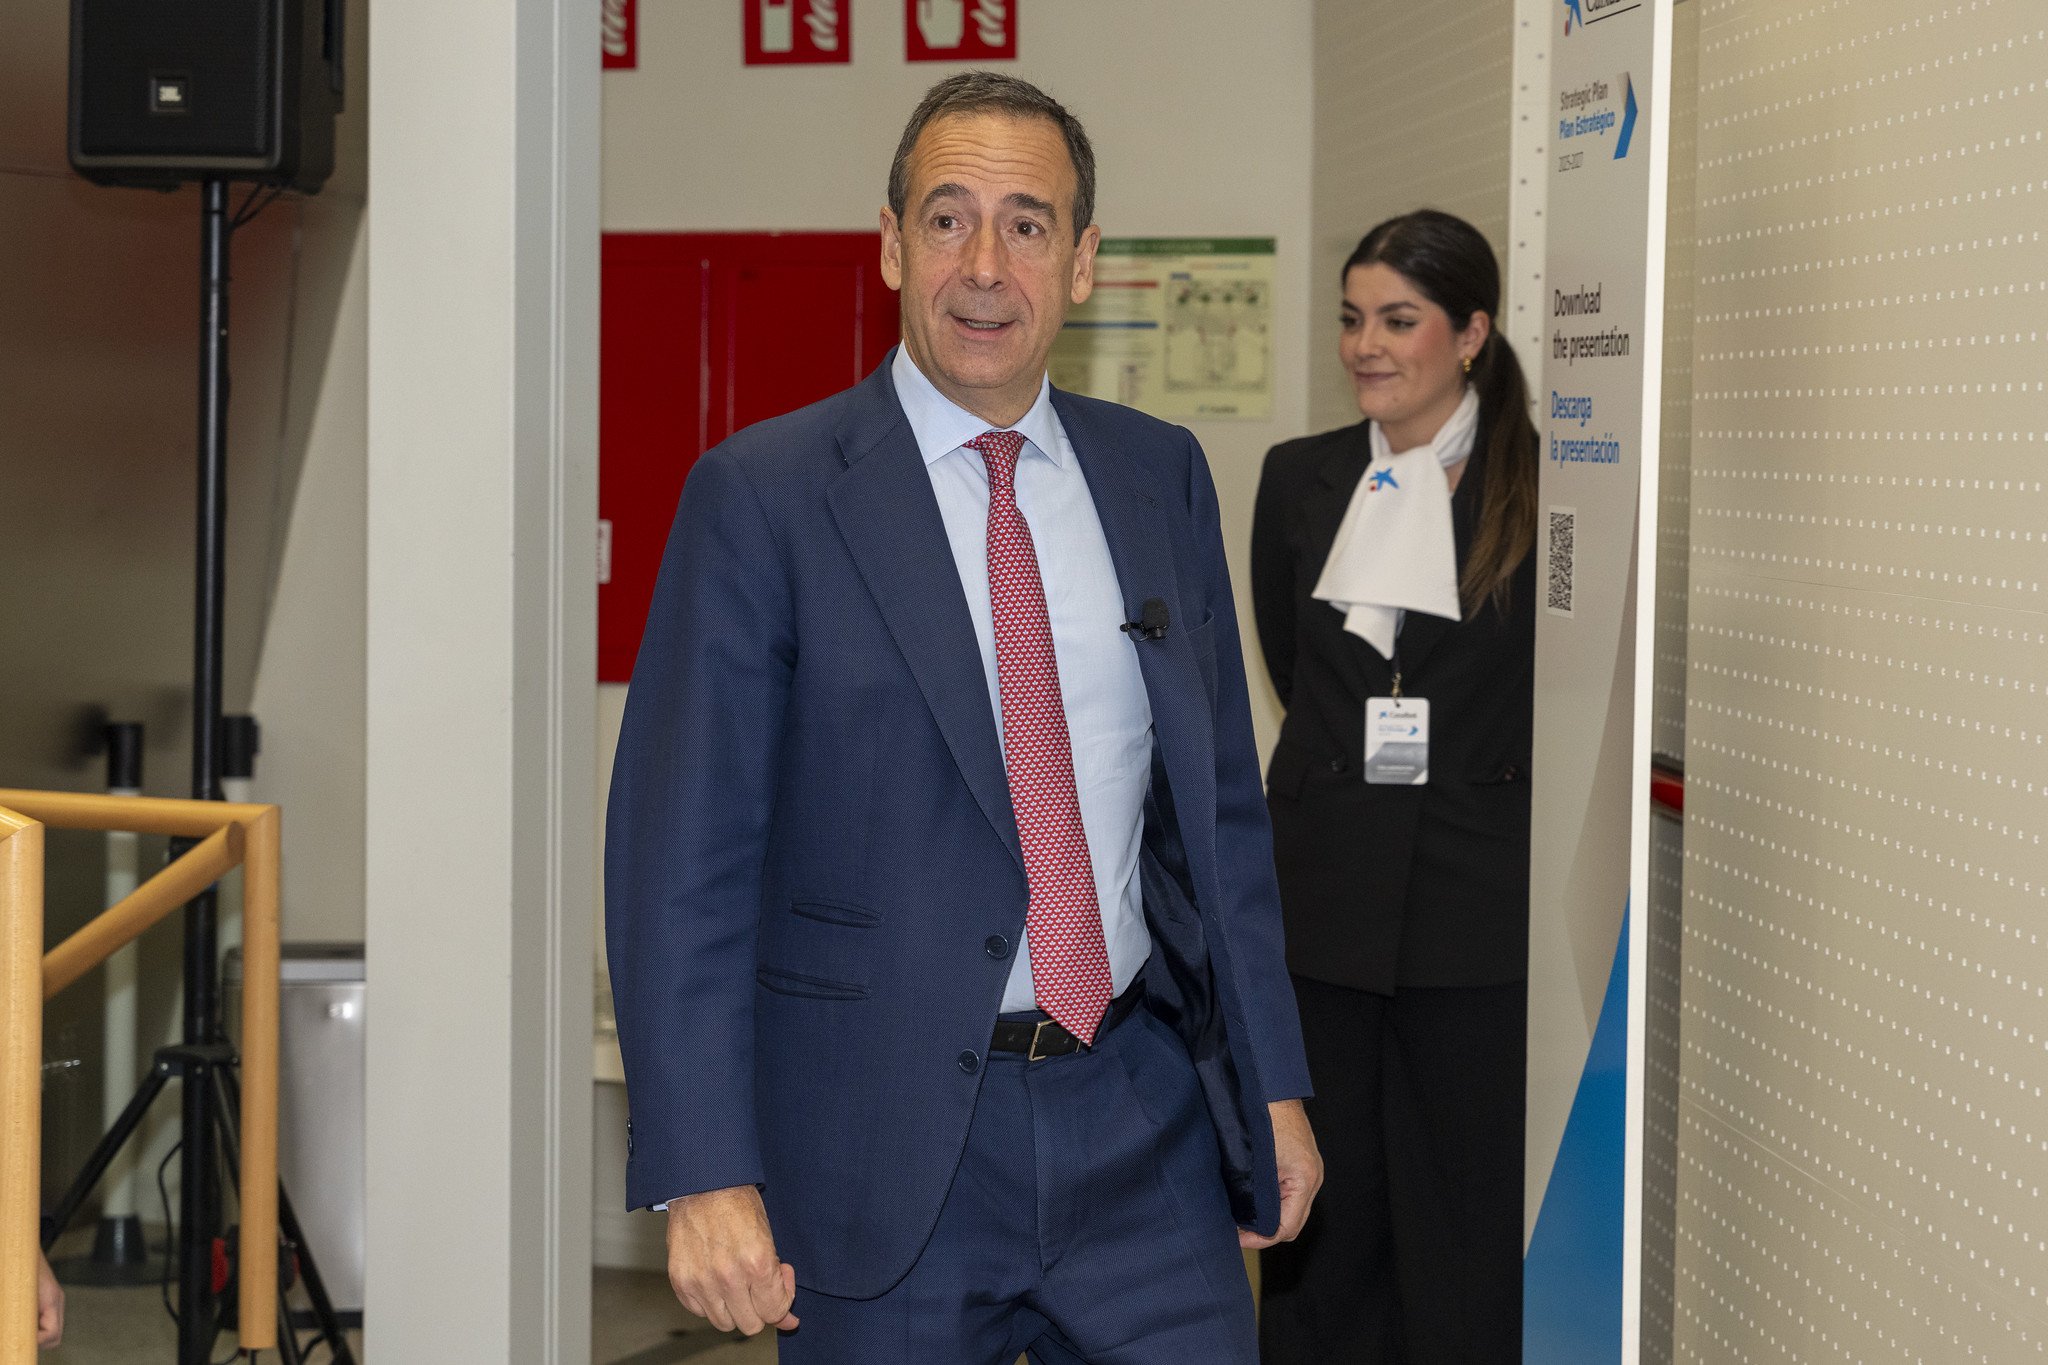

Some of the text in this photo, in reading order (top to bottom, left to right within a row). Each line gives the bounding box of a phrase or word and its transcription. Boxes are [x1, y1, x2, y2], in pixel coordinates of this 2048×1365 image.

[1560, 80, 1608, 111] Strategic Plan
[1559, 107, 1615, 140] Plan Estratégico
[1554, 282, 1602, 317] Download
[1553, 325, 1629, 366] the presentation
[1552, 390, 1592, 427] Descarga
[1550, 431, 1619, 469] la presentación
